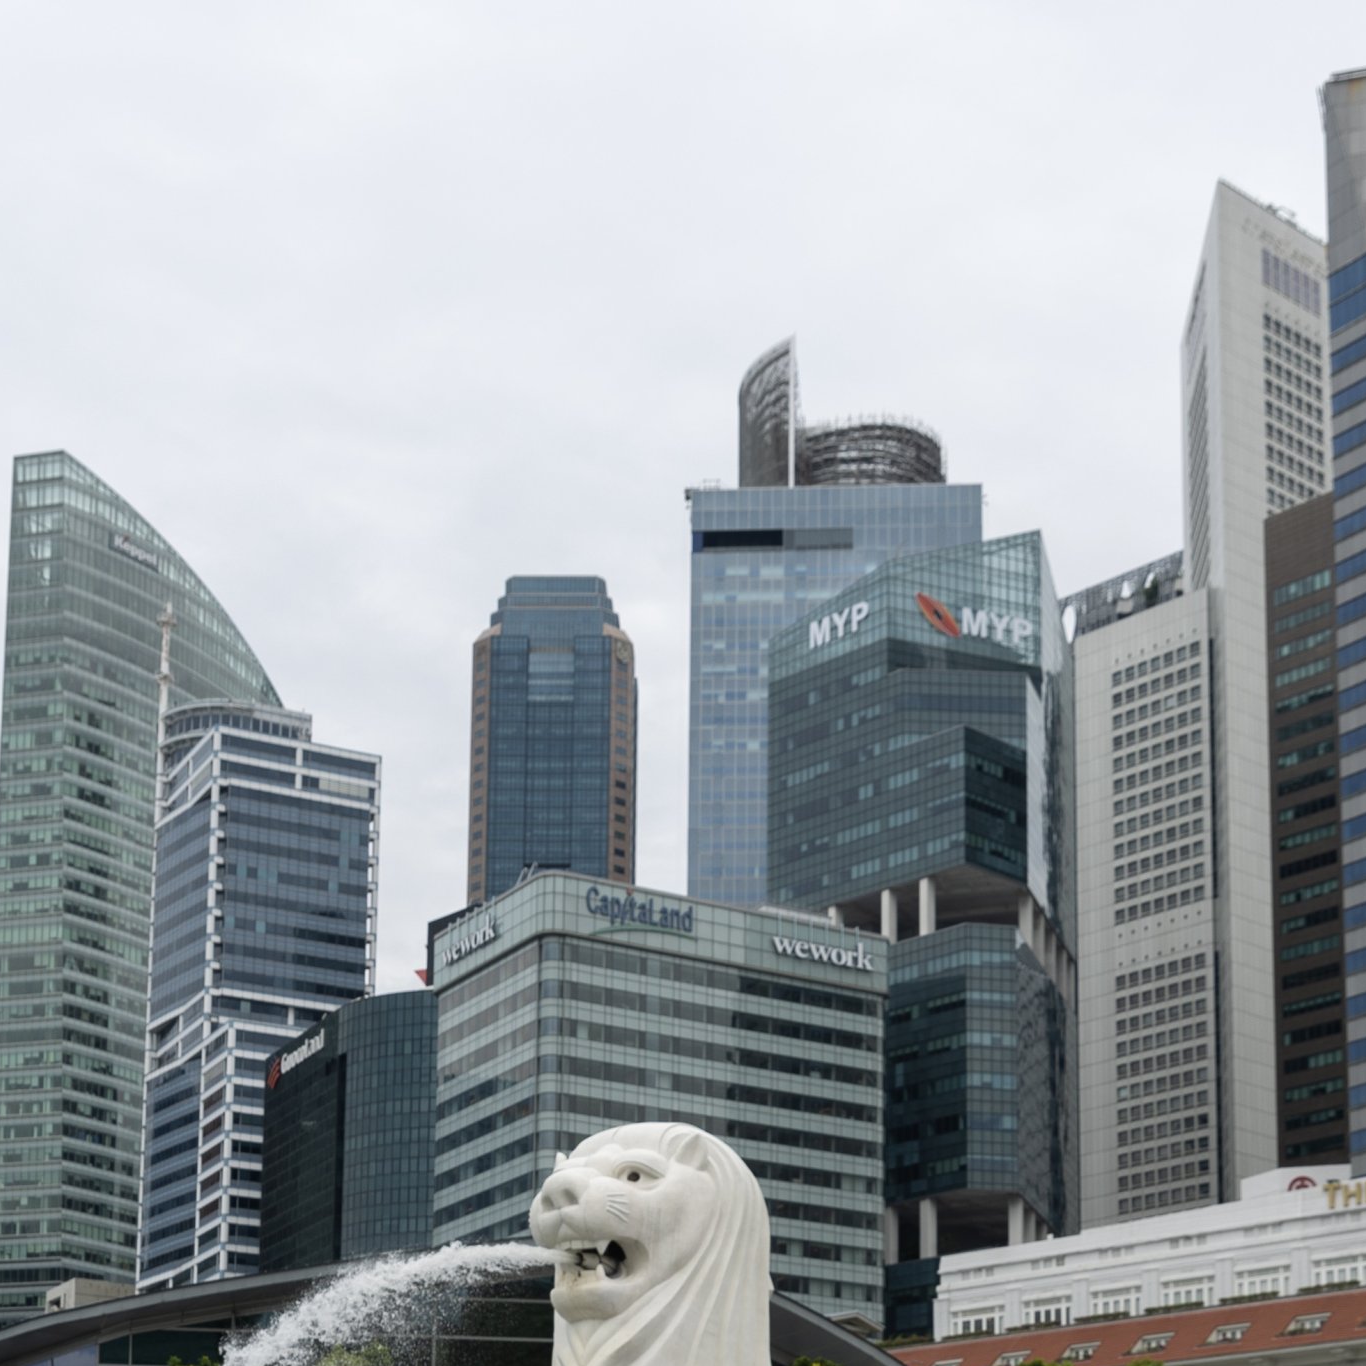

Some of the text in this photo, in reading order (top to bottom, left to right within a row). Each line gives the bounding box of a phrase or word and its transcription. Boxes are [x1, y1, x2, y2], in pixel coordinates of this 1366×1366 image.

[114, 535, 157, 564] Keppel
[808, 601, 870, 650] MYP
[961, 606, 1033, 644] MYP
[585, 885, 694, 933] CapitaLand
[440, 915, 497, 966] wework
[772, 934, 873, 971] wework
